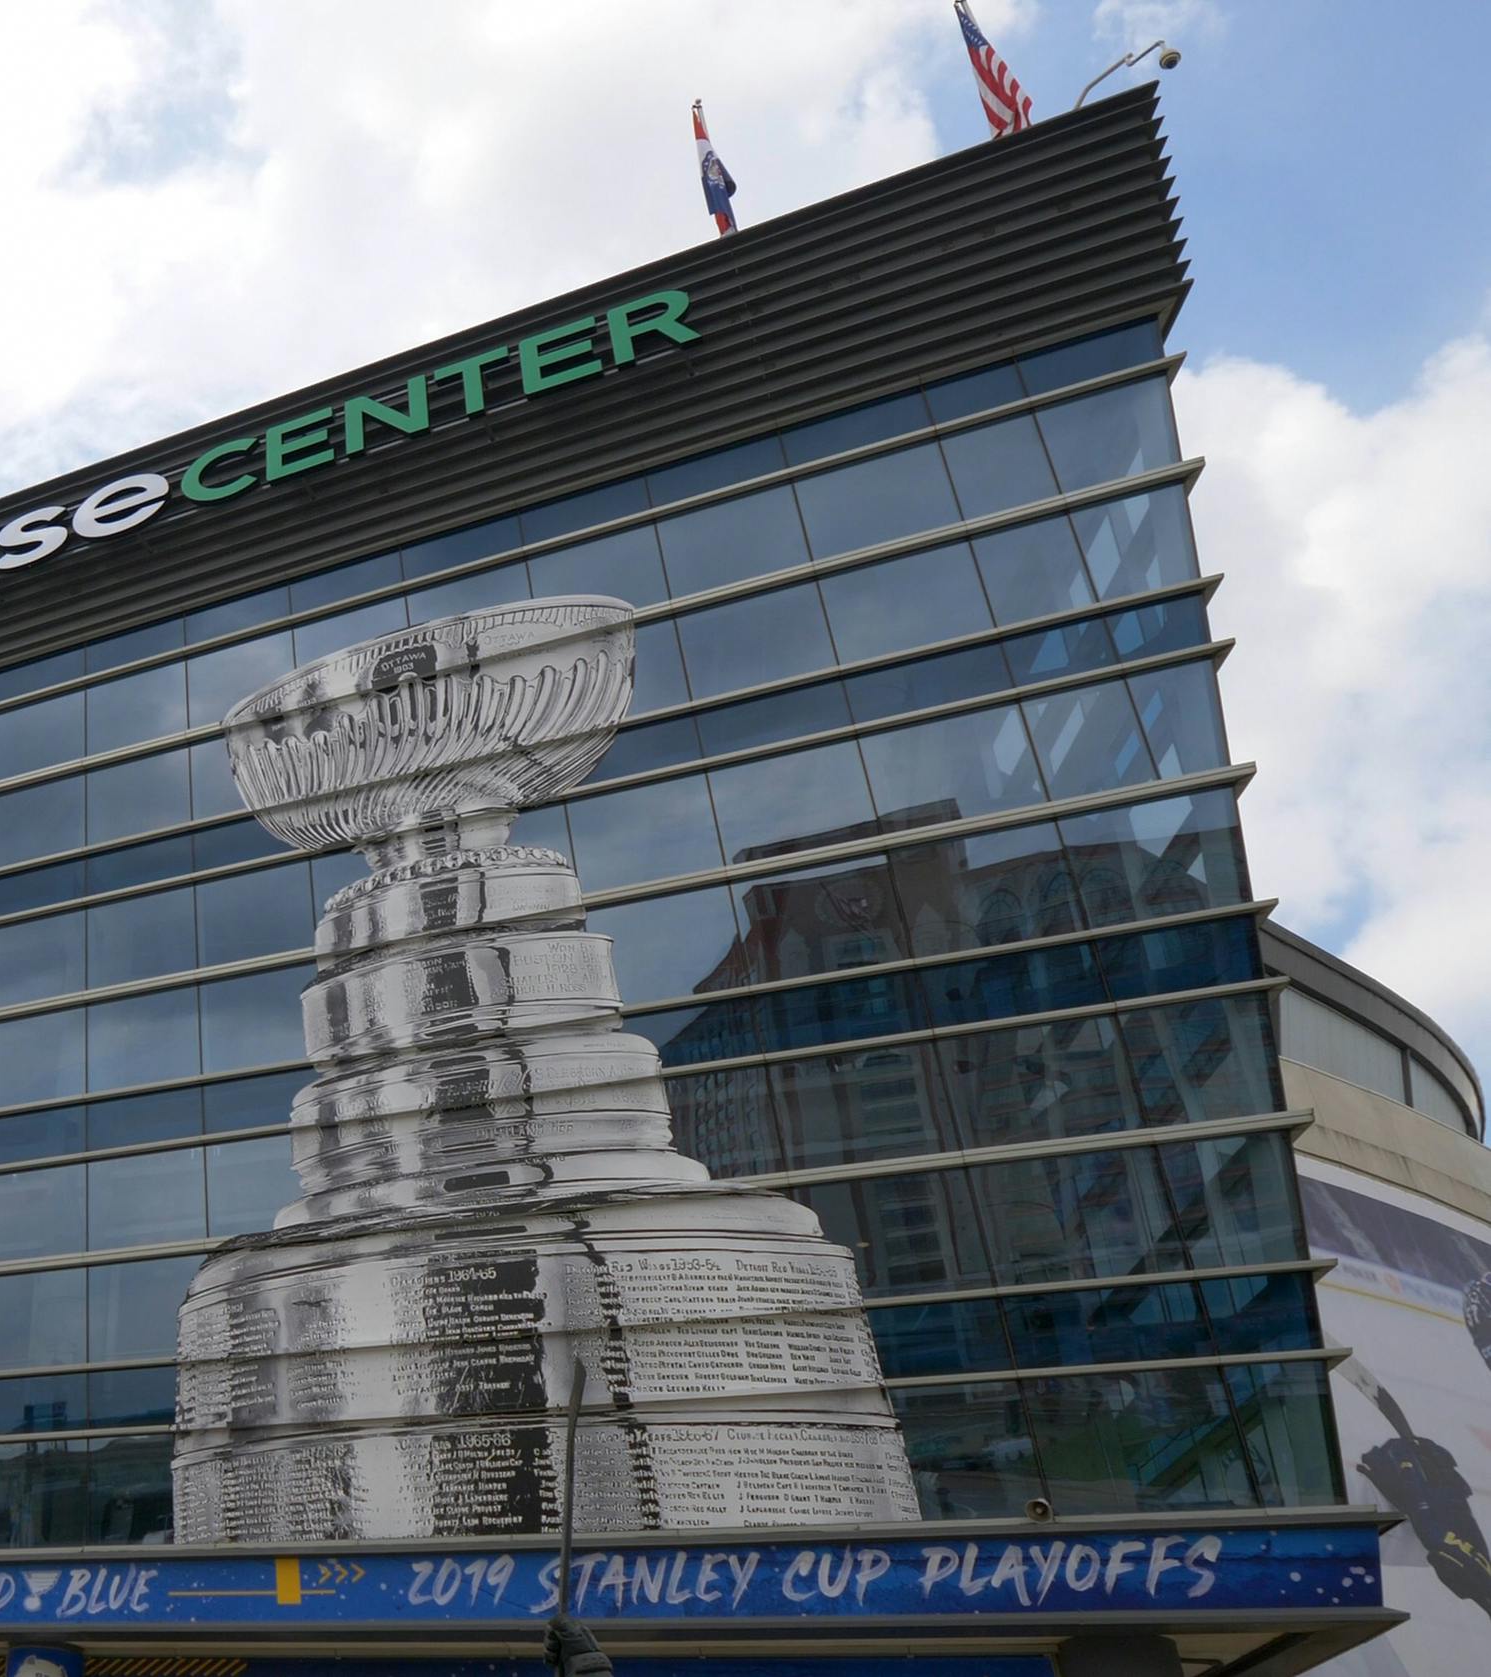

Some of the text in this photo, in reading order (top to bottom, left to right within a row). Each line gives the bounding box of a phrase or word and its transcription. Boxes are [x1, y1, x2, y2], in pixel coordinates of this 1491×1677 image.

[180, 290, 703, 502] CENTER
[380, 651, 427, 672] OTTAWA
[393, 662, 415, 674] 1903
[55, 1562, 158, 1619] BLUE
[409, 1535, 1223, 1614] 2019 STANLEY CUP PLAYOFFS
